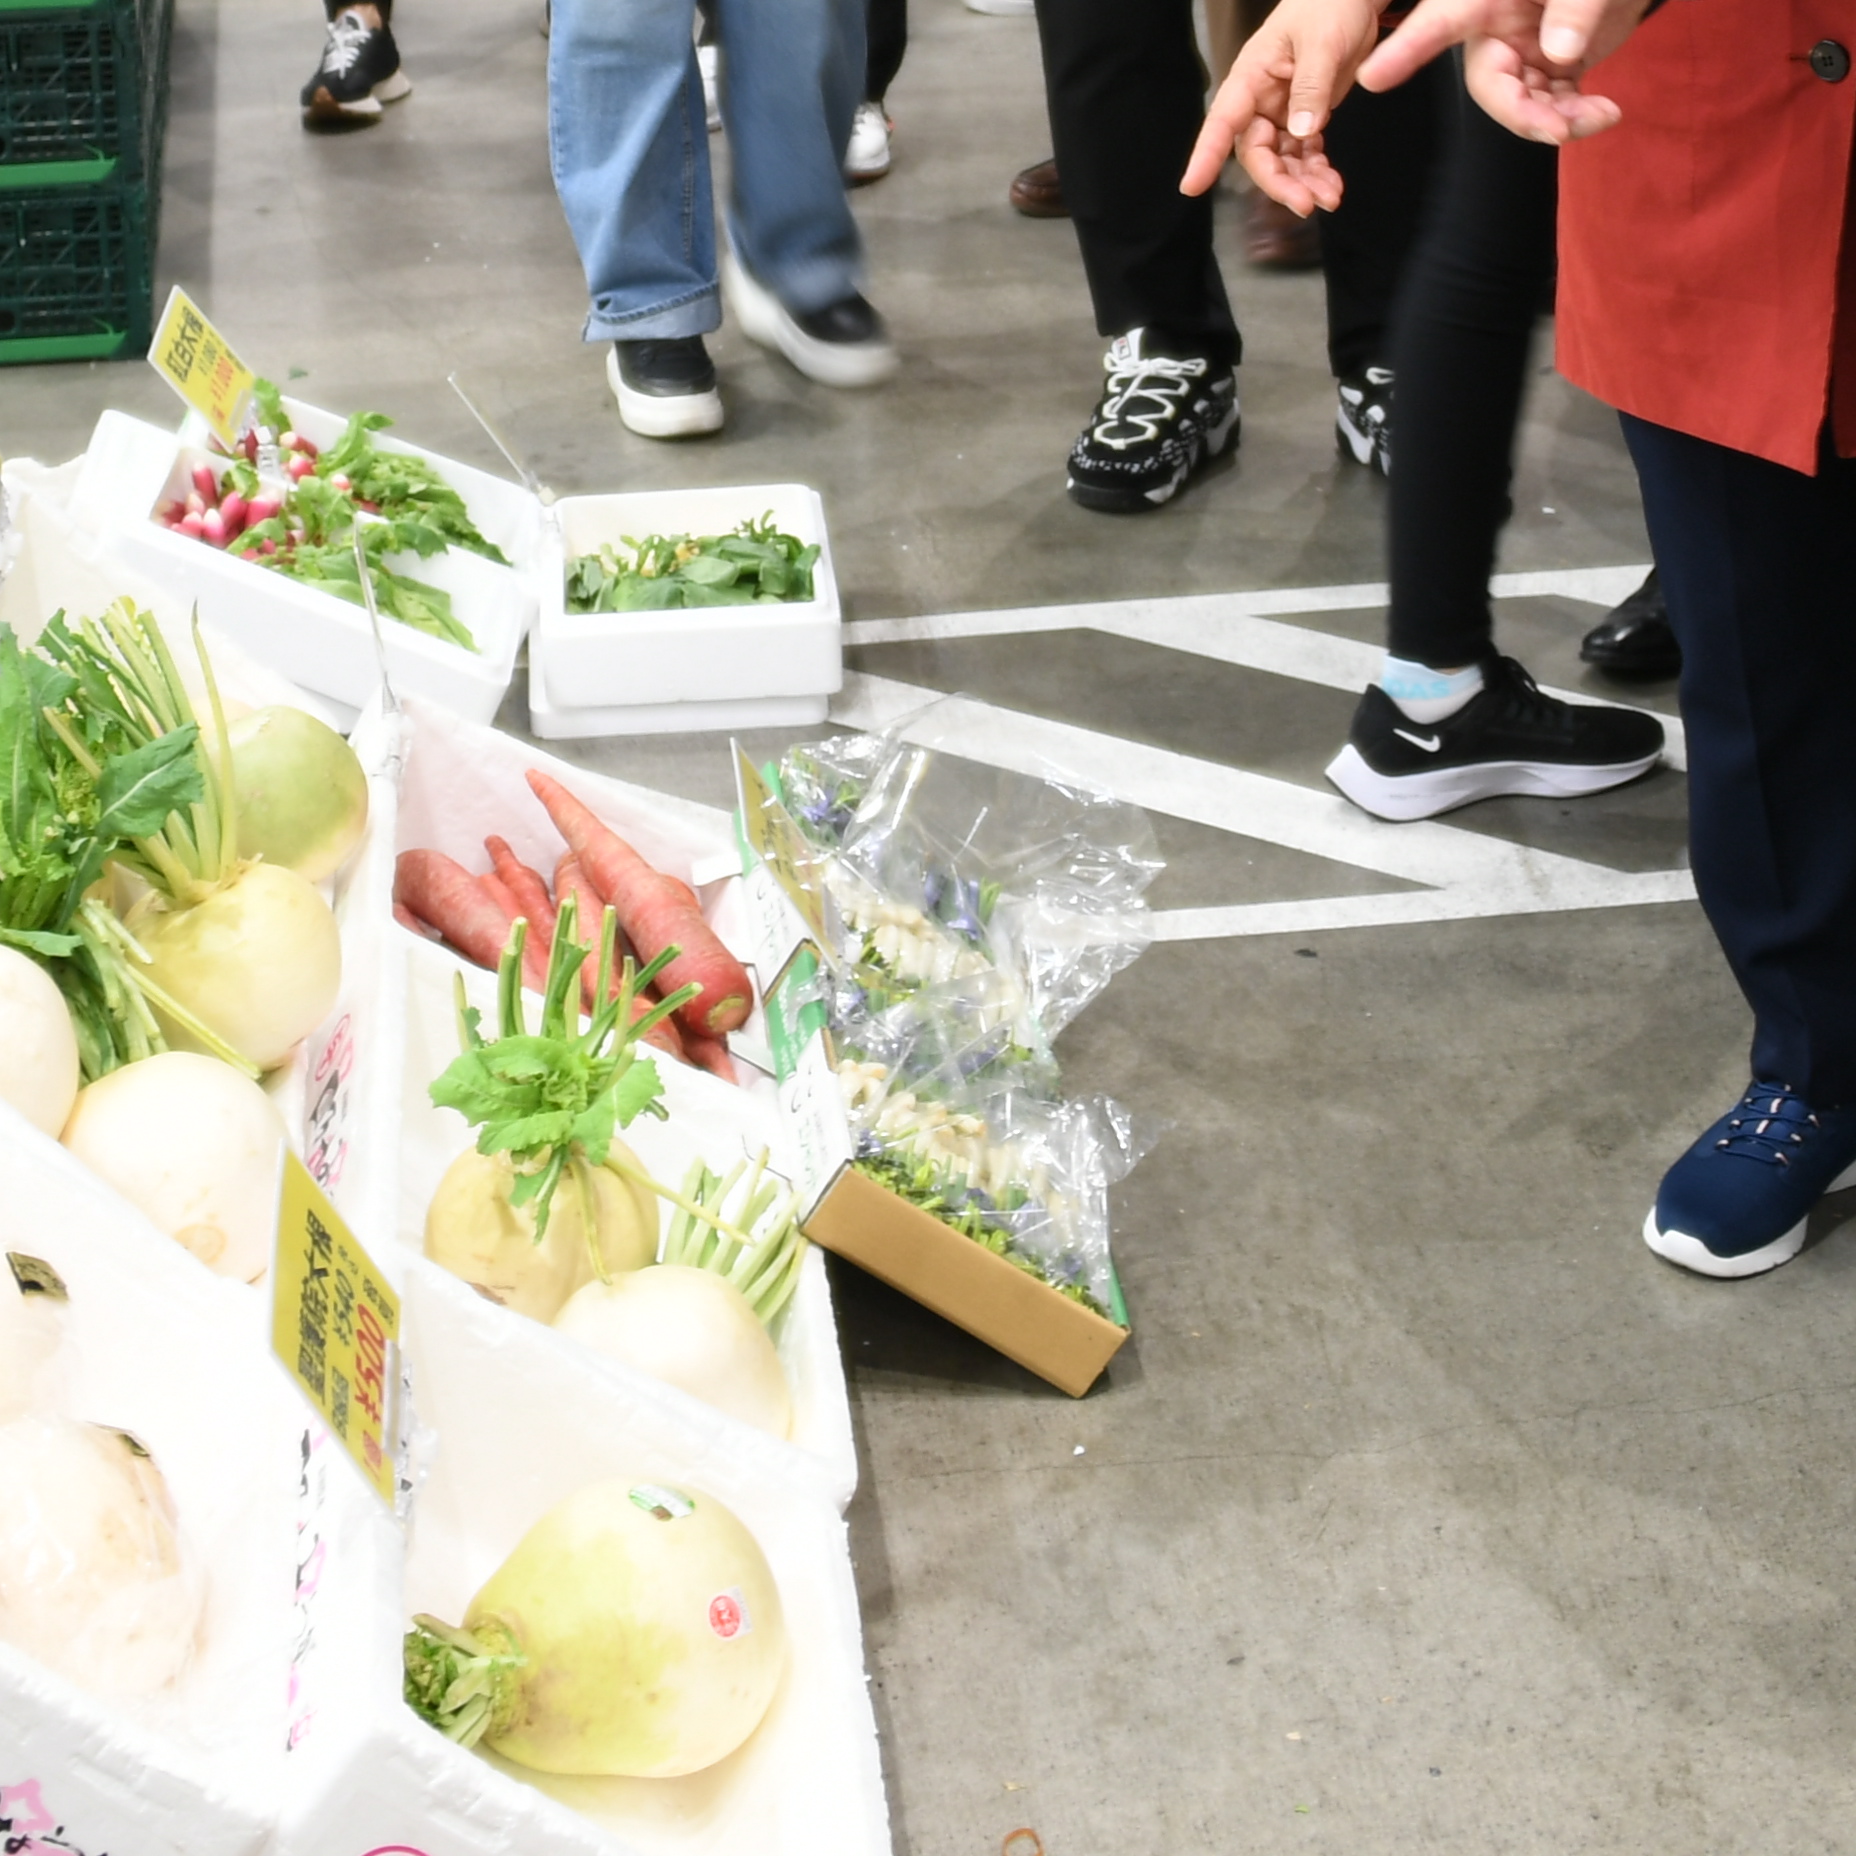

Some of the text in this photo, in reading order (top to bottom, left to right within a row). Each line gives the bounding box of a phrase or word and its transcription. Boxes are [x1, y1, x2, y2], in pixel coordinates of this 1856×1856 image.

[297, 1208, 334, 1407] 聖護院大根
[333, 1267, 356, 1347] ¥540
[354, 1302, 386, 1425] ¥500
